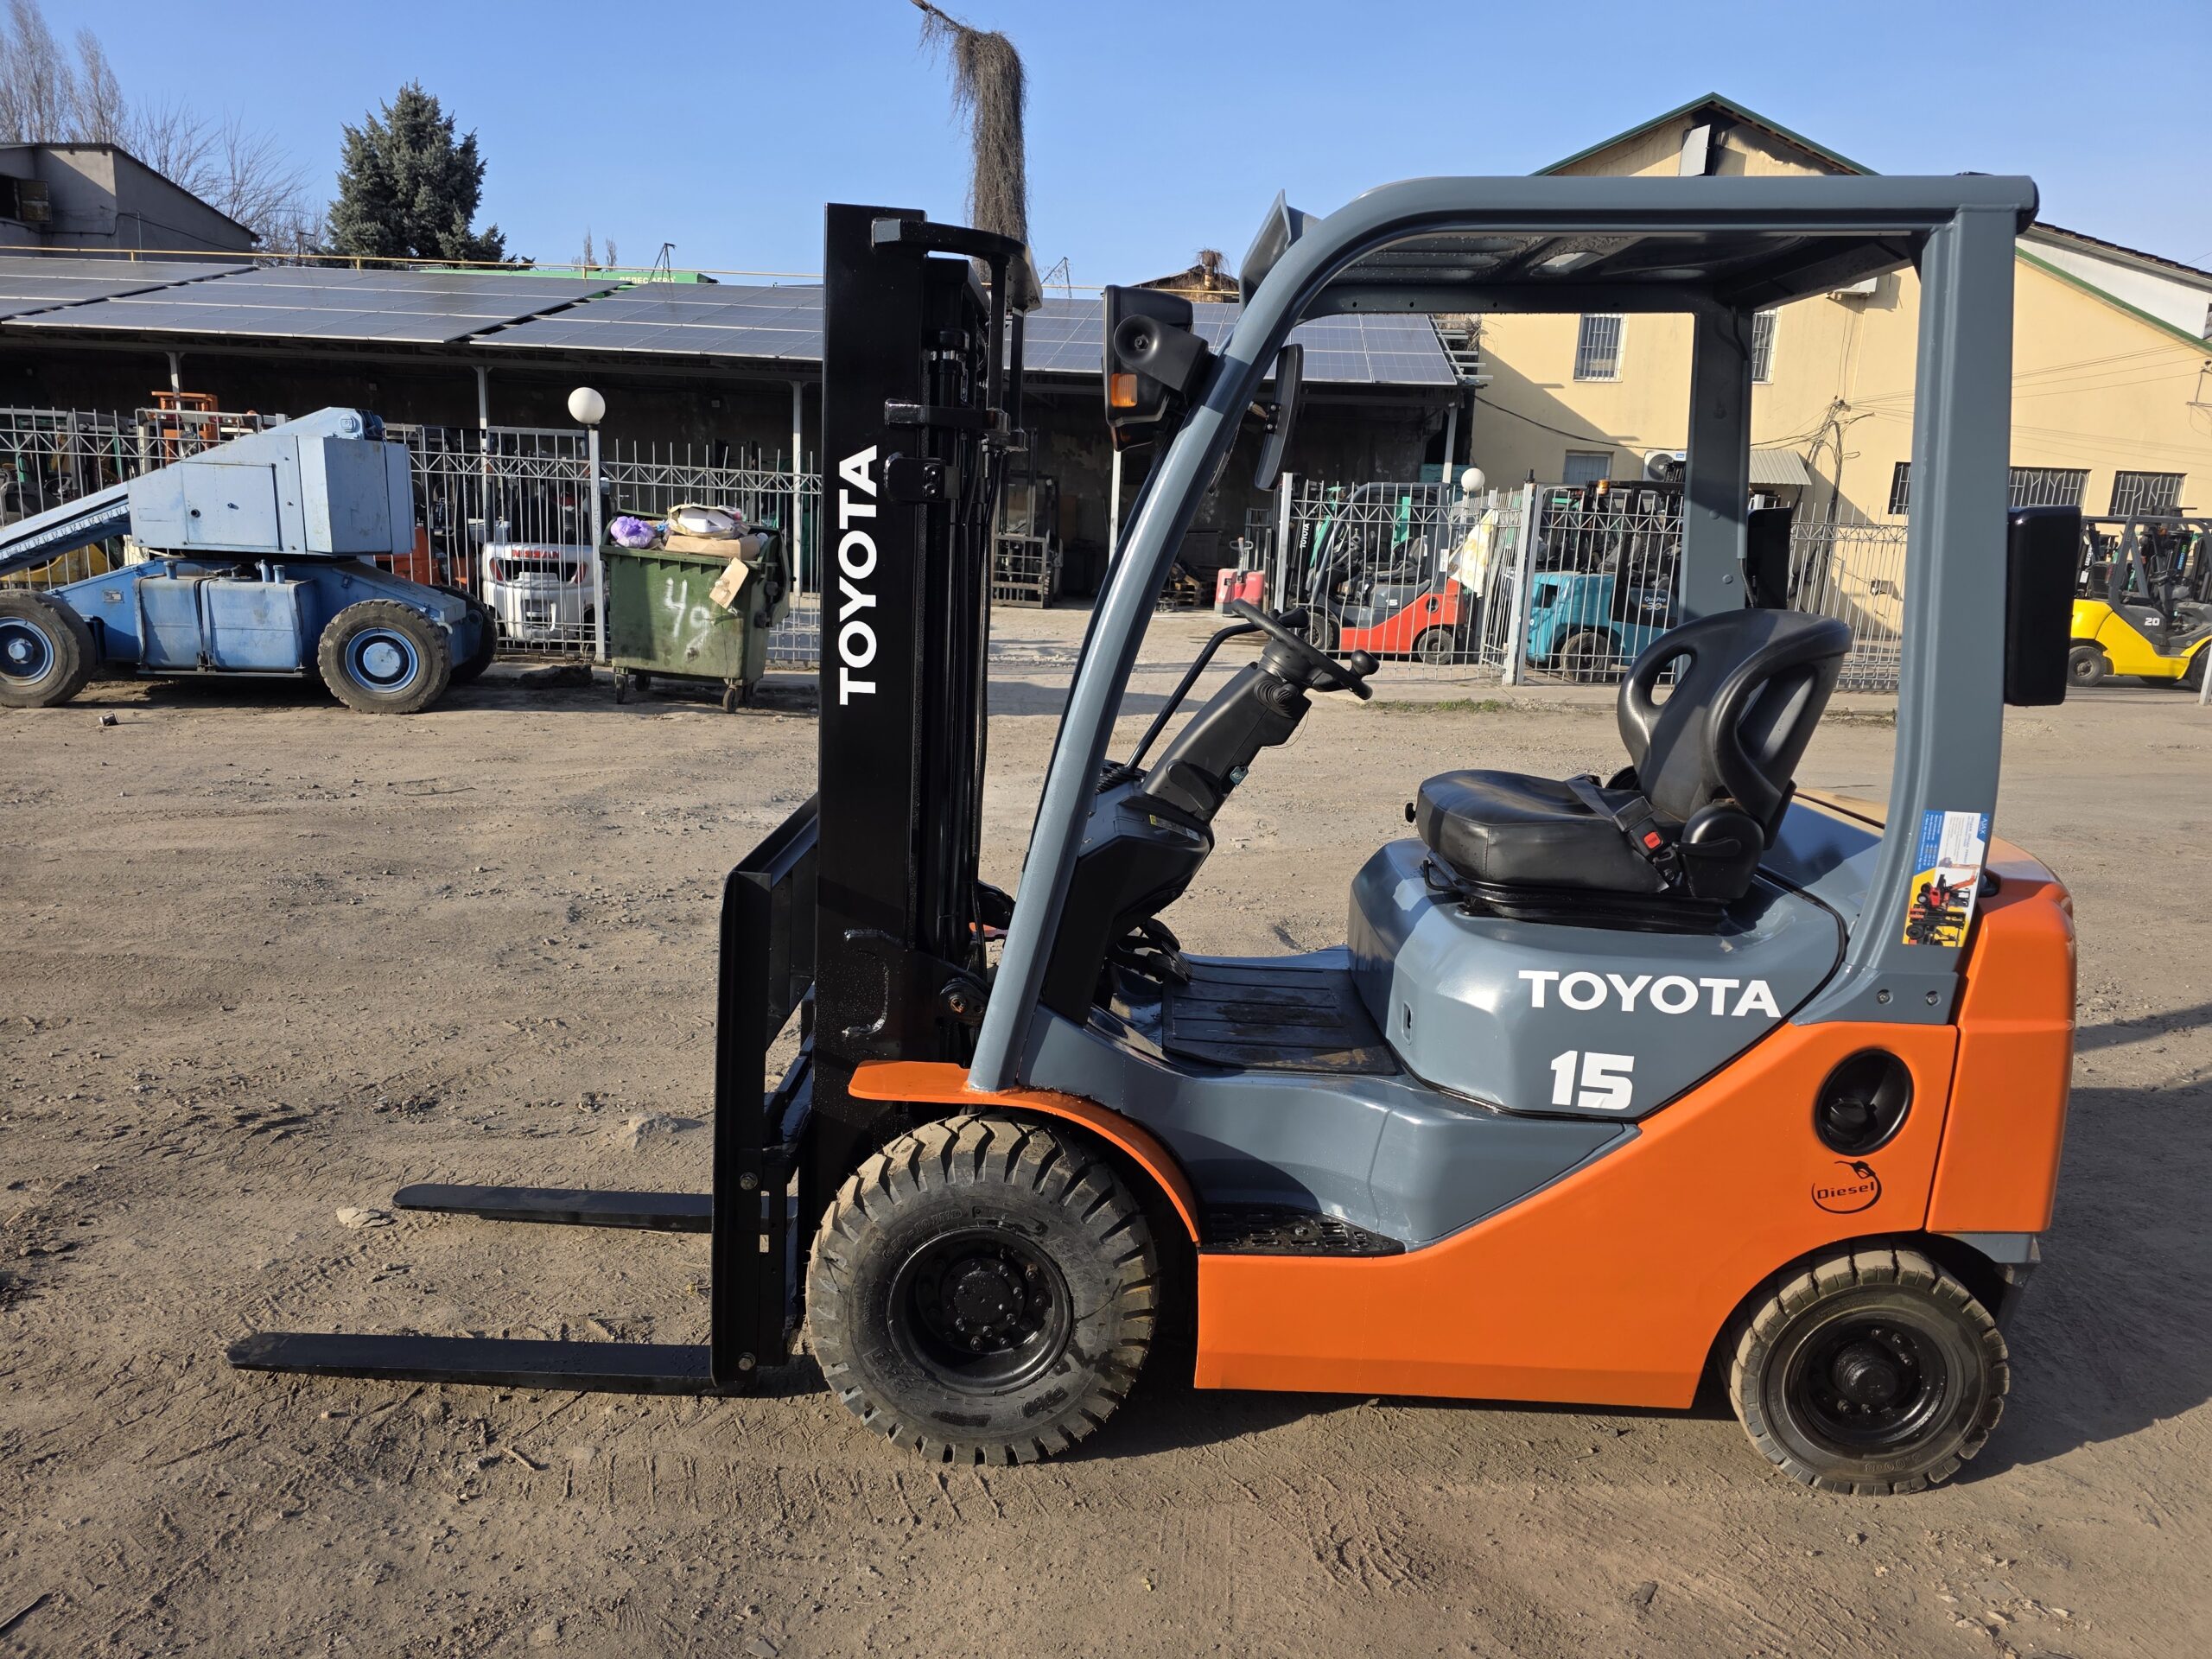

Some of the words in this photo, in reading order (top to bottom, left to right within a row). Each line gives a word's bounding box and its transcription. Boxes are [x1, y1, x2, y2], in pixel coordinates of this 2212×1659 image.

[512, 550, 560, 559] NSSAN
[837, 445, 878, 706] TOYOTA
[1646, 602, 1662, 611] 30
[2145, 617, 2160, 626] 20
[1980, 817, 1988, 835] AJAX
[1518, 969, 1782, 1018] TOYOTA
[1550, 1050, 1635, 1110] 15
[1817, 1181, 1875, 1199] Diesel
